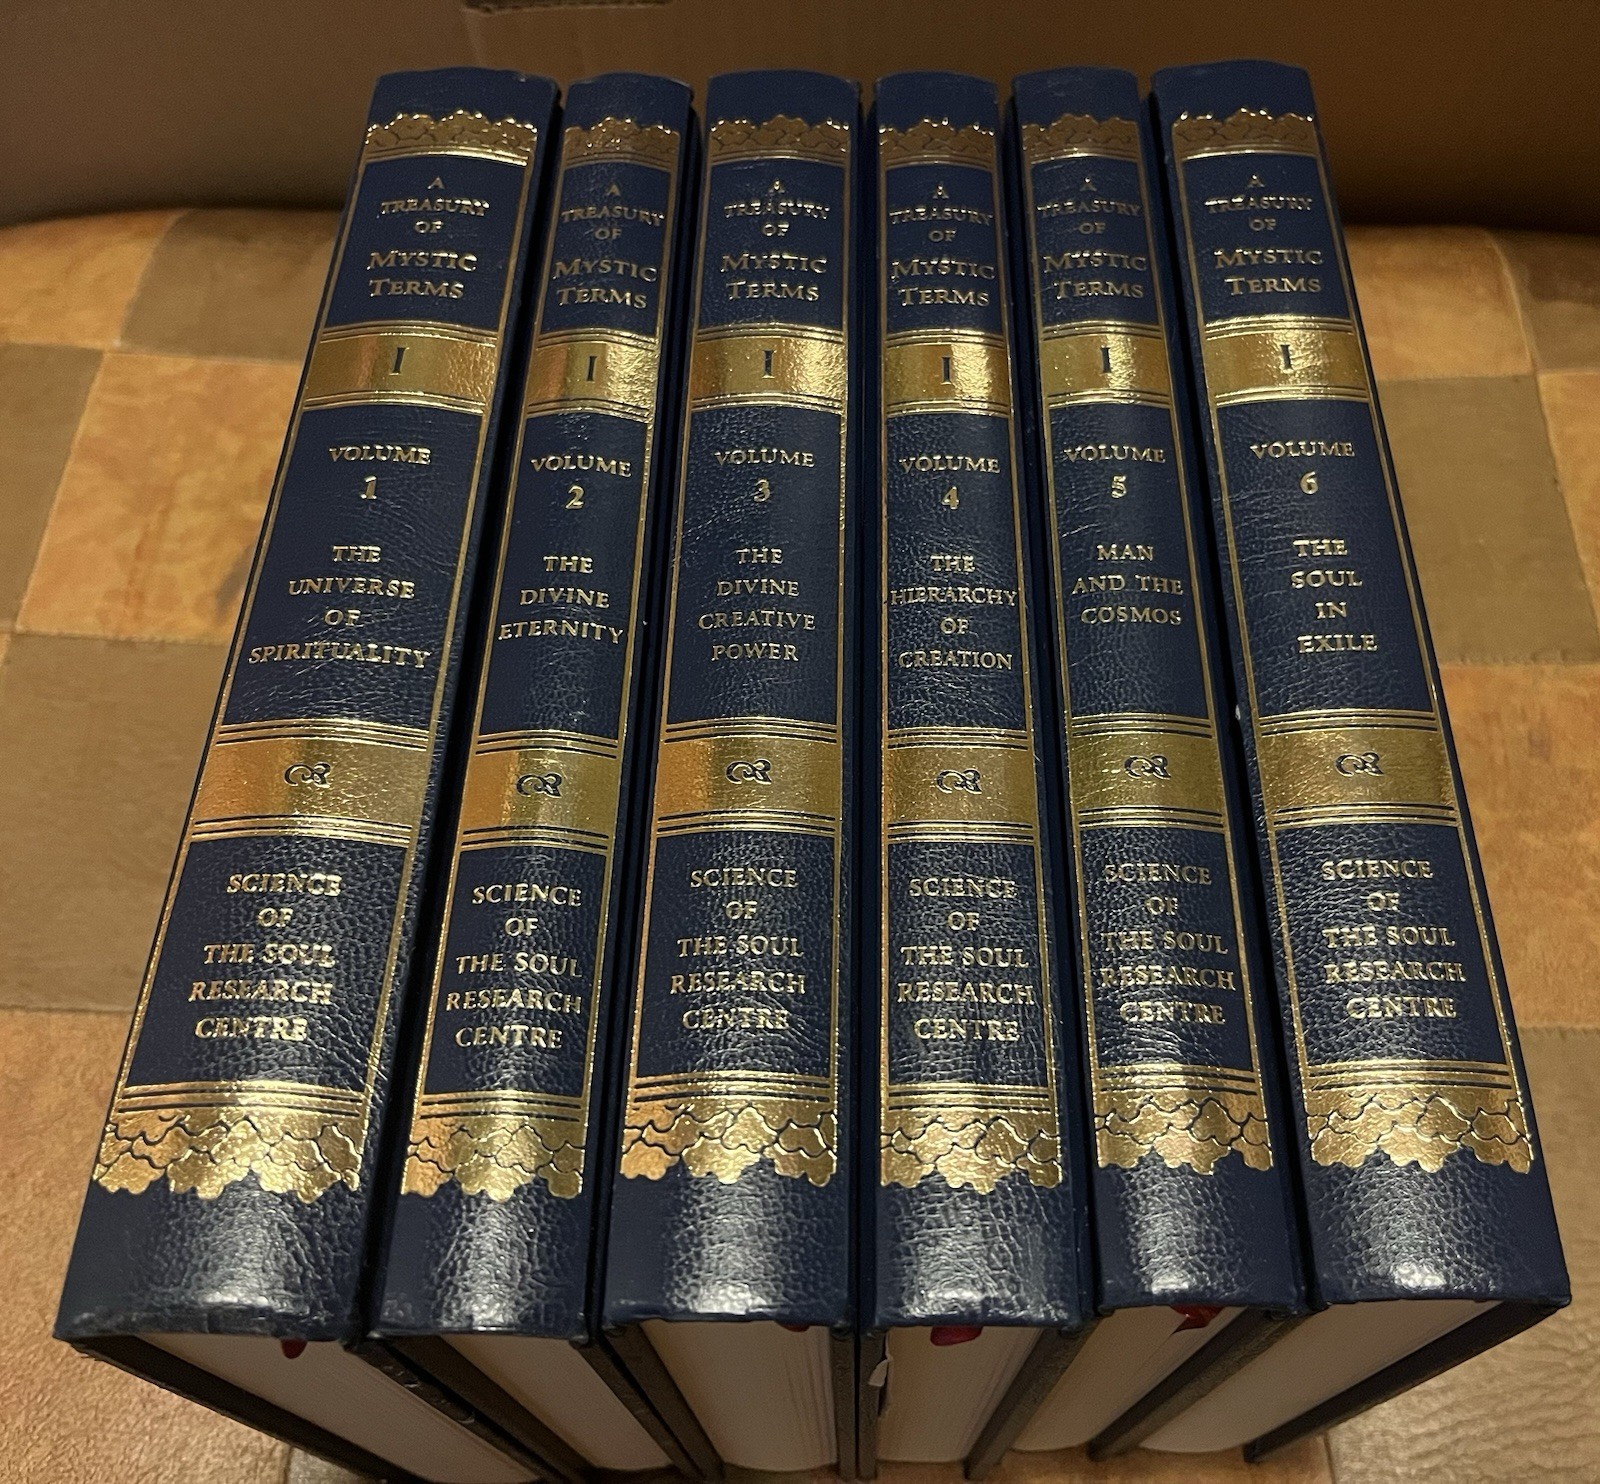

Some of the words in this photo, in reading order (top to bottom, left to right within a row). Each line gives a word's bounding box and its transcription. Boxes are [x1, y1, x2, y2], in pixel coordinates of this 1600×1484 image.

[428, 177, 444, 190] A
[606, 184, 621, 197] A
[769, 179, 785, 193] A
[1080, 177, 1097, 191] A
[1248, 174, 1265, 188] A
[932, 184, 949, 199] A
[381, 199, 490, 217] TREASURY
[724, 202, 830, 219] TREASURY
[1037, 200, 1142, 218] TREASURY
[1204, 196, 1313, 213] TREASURY
[561, 206, 665, 227] TREASURY
[889, 208, 993, 226] TREASURY
[1251, 219, 1277, 231] OF
[414, 220, 444, 234] OF
[594, 226, 621, 240] OF
[762, 221, 789, 236] OF
[929, 229, 956, 242] OF
[1079, 221, 1106, 235] OF
[389, 347, 409, 376] I
[761, 349, 775, 379] I
[1100, 347, 1111, 373] I
[1280, 344, 1294, 373] I
[586, 356, 597, 382] I
[941, 356, 951, 385] I
[329, 445, 431, 465] VOLUME
[714, 449, 815, 467] VOLUME
[1064, 445, 1165, 463] VOLUME
[1250, 440, 1355, 459] VOLUME
[531, 455, 632, 477] VOLUME
[899, 455, 1000, 473] VOLUME
[360, 476, 377, 499] 1
[753, 479, 771, 502] 3
[1111, 475, 1127, 499] 5
[1300, 471, 1319, 494] 6
[565, 485, 585, 510] 2
[942, 486, 960, 510] 4
[333, 545, 381, 562] THE
[736, 548, 783, 564] THE
[1097, 544, 1154, 561] MAN
[1293, 539, 1347, 557] THE
[543, 556, 594, 573] THE
[930, 555, 975, 573] THE
[289, 577, 415, 599] UNIVERSE
[717, 579, 800, 597] DIVINE
[1071, 574, 1125, 595] AND
[1135, 574, 1183, 595] THE
[1290, 570, 1363, 589] SOUL
[520, 588, 610, 608] DIVINE
[890, 586, 1017, 606] HIERARCHY
[325, 610, 361, 627] OF
[698, 610, 816, 630] CREATIVE
[1081, 606, 1182, 625] COSMOS
[1315, 602, 1347, 619] IN
[498, 620, 624, 644] ETERNITY
[940, 617, 969, 634] OF
[711, 643, 799, 662] POWER
[1297, 634, 1378, 653] EXILE
[249, 641, 431, 668] SPIRITUALITY
[899, 650, 1013, 670] CREATION
[690, 868, 799, 888] SCIENCE
[1104, 862, 1212, 885] SCIENCE
[1321, 860, 1433, 881] SCIENCE
[226, 873, 342, 896] SCIENCE
[909, 878, 1018, 898] SCIENCE
[472, 883, 582, 907] SCIENCE
[1367, 892, 1400, 911] OF
[725, 901, 757, 920] OF
[1145, 896, 1178, 915] OF
[257, 907, 293, 927] OF
[505, 917, 539, 936] OF
[948, 911, 980, 931] OF
[677, 936, 727, 957] THE
[735, 935, 804, 957] SOUL
[1101, 931, 1154, 951] THE
[1163, 931, 1228, 954] SOUL
[1322, 926, 1378, 948] THE
[1386, 926, 1456, 946] SOUL
[204, 943, 255, 964] THE
[262, 943, 336, 968] SOUL
[456, 954, 504, 975] THE
[514, 952, 582, 977] SOUL
[900, 946, 954, 966] THE
[962, 946, 1029, 968] SOUL
[1100, 965, 1236, 991] RESEARCH
[1324, 960, 1466, 984] RESEARCH
[188, 979, 334, 1005] RESEARCH
[670, 971, 806, 994] RESEARCH
[446, 988, 582, 1014] RESEARCH
[897, 982, 1035, 1005] RESEARCH
[1120, 1001, 1226, 1024] CENTRE
[1346, 996, 1457, 1019] CENTRE
[682, 1007, 789, 1029] CENTRE
[195, 1016, 307, 1041] CENTRE
[455, 1025, 563, 1048] CENTRE
[914, 1018, 1020, 1041] CENTRE
